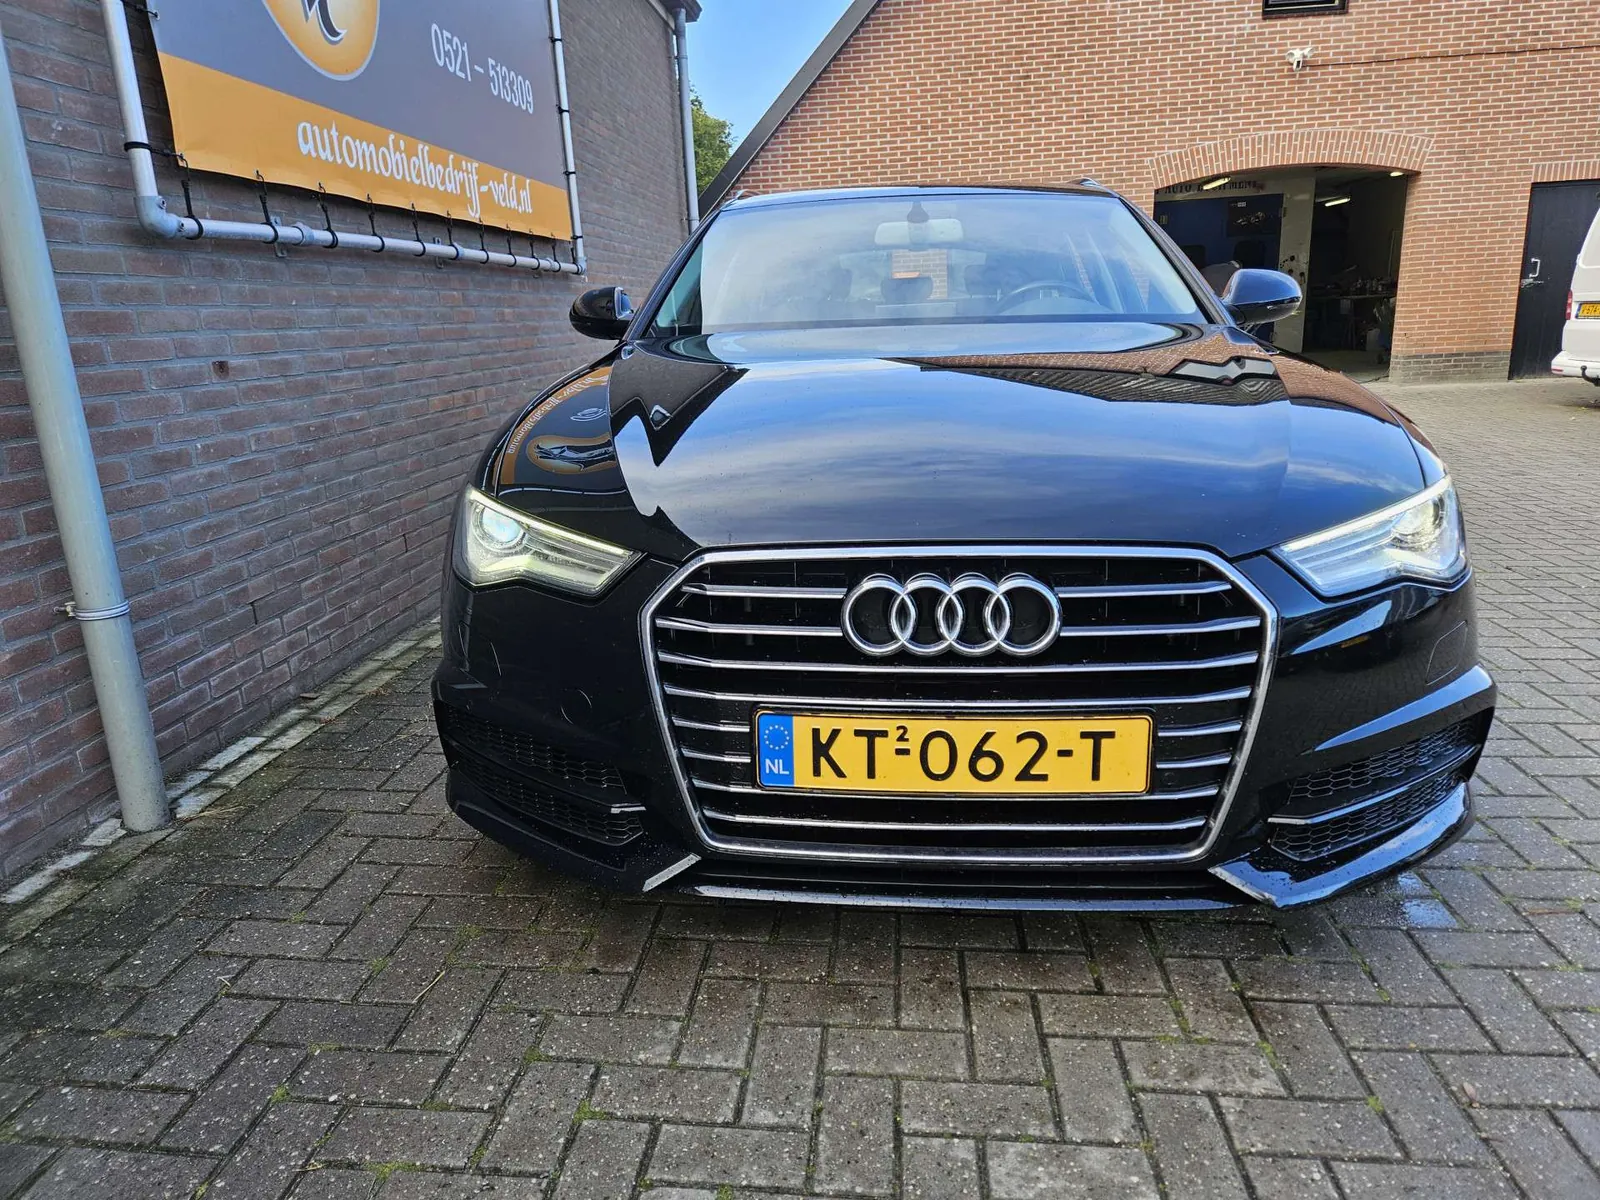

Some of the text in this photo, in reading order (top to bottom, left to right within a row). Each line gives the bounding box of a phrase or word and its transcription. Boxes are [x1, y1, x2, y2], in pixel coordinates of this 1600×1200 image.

[431, 23, 472, 82] 0521
[488, 57, 534, 114] 513309
[297, 120, 533, 218] automobielbedrijf-veld.nl
[765, 758, 790, 775] NL
